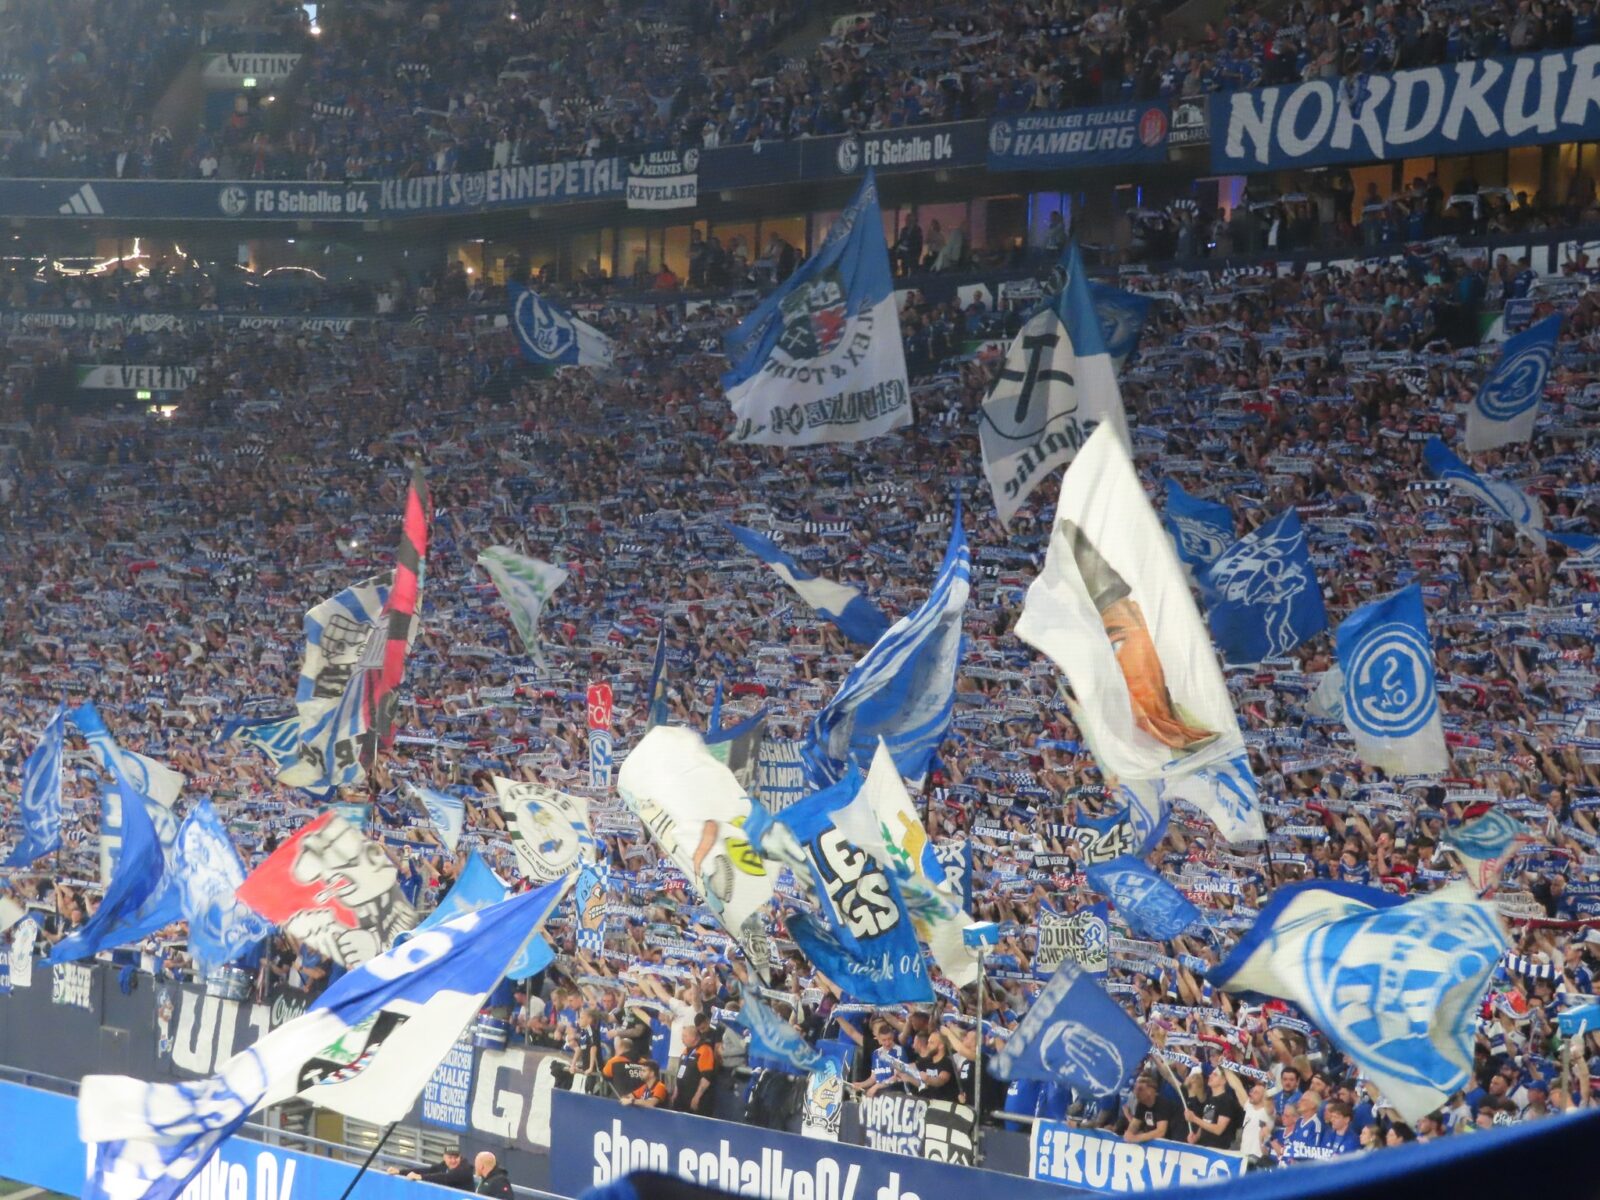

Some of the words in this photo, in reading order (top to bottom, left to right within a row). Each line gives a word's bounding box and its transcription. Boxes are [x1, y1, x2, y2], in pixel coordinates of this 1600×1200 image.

[1016, 116, 1083, 132] SCHALKER
[1086, 109, 1136, 125] FILIALE
[864, 141, 880, 165] FC
[881, 136, 931, 163] Schalke
[934, 133, 952, 159] 04
[1013, 126, 1135, 156] HAMBURG
[487, 157, 625, 201] ENNEPETAL
[628, 184, 696, 201] KEVELAER
[255, 191, 276, 212] FC
[278, 189, 341, 213] Schalke
[346, 191, 368, 213] 04
[1056, 928, 1085, 946] UNS
[900, 953, 921, 979] 04
[858, 1094, 928, 1140] MARLER
[1051, 1130, 1209, 1194] KURVE
